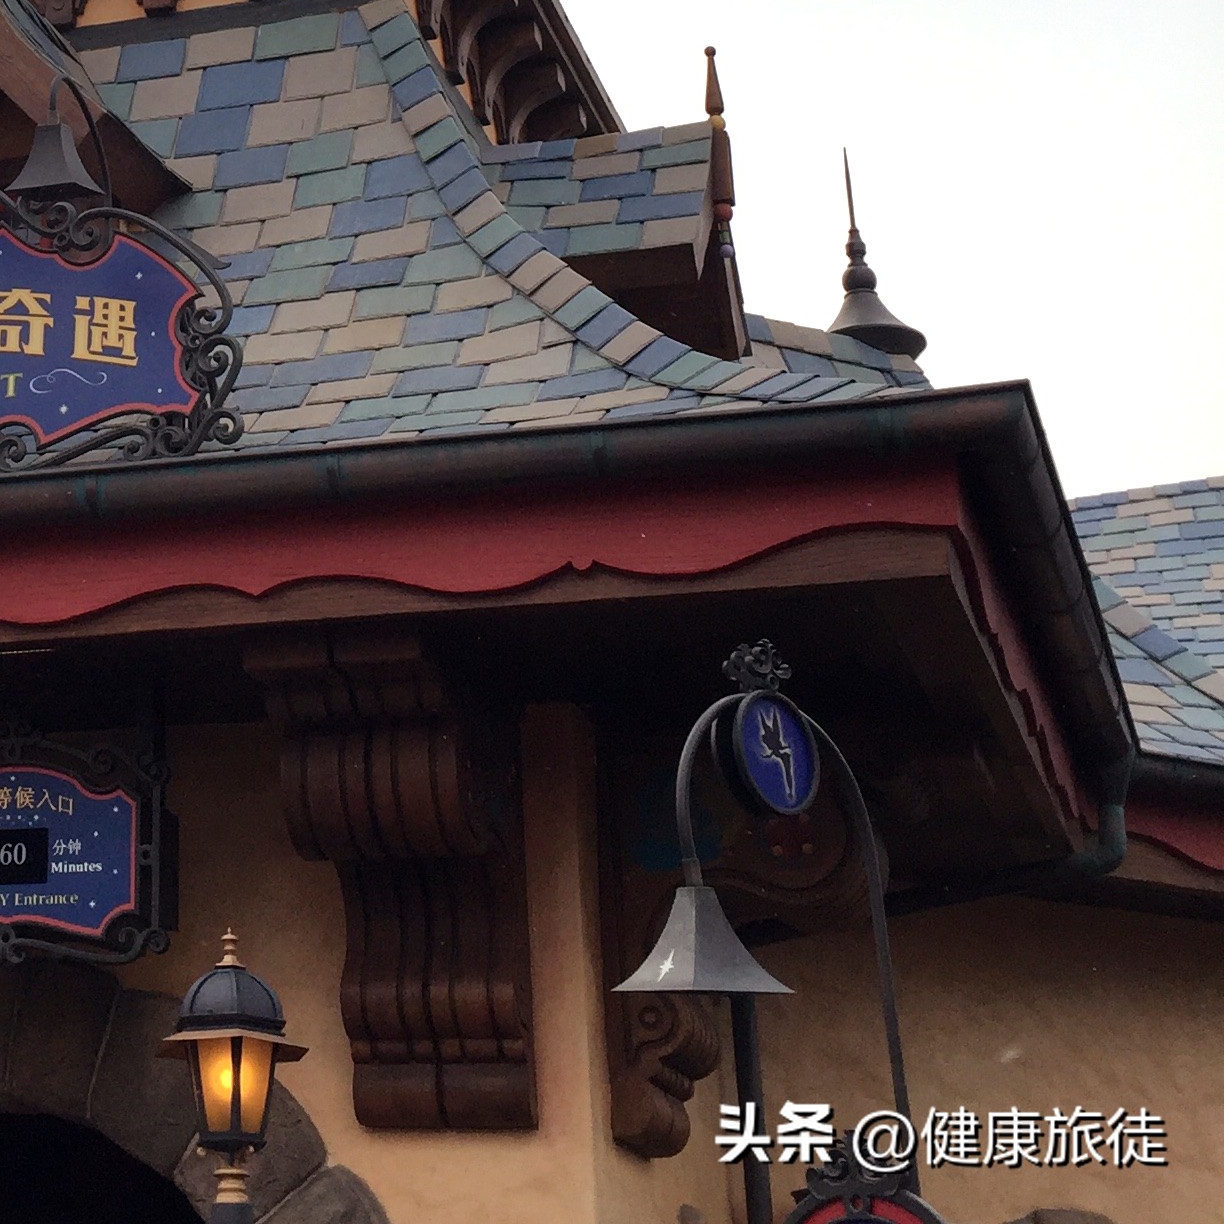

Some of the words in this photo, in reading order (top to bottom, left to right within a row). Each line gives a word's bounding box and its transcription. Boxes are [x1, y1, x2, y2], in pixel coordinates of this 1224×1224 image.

[0, 842, 27, 866] 60
[52, 838, 82, 857] 分钟
[51, 861, 103, 874] Minutes
[14, 892, 79, 907] Entrance
